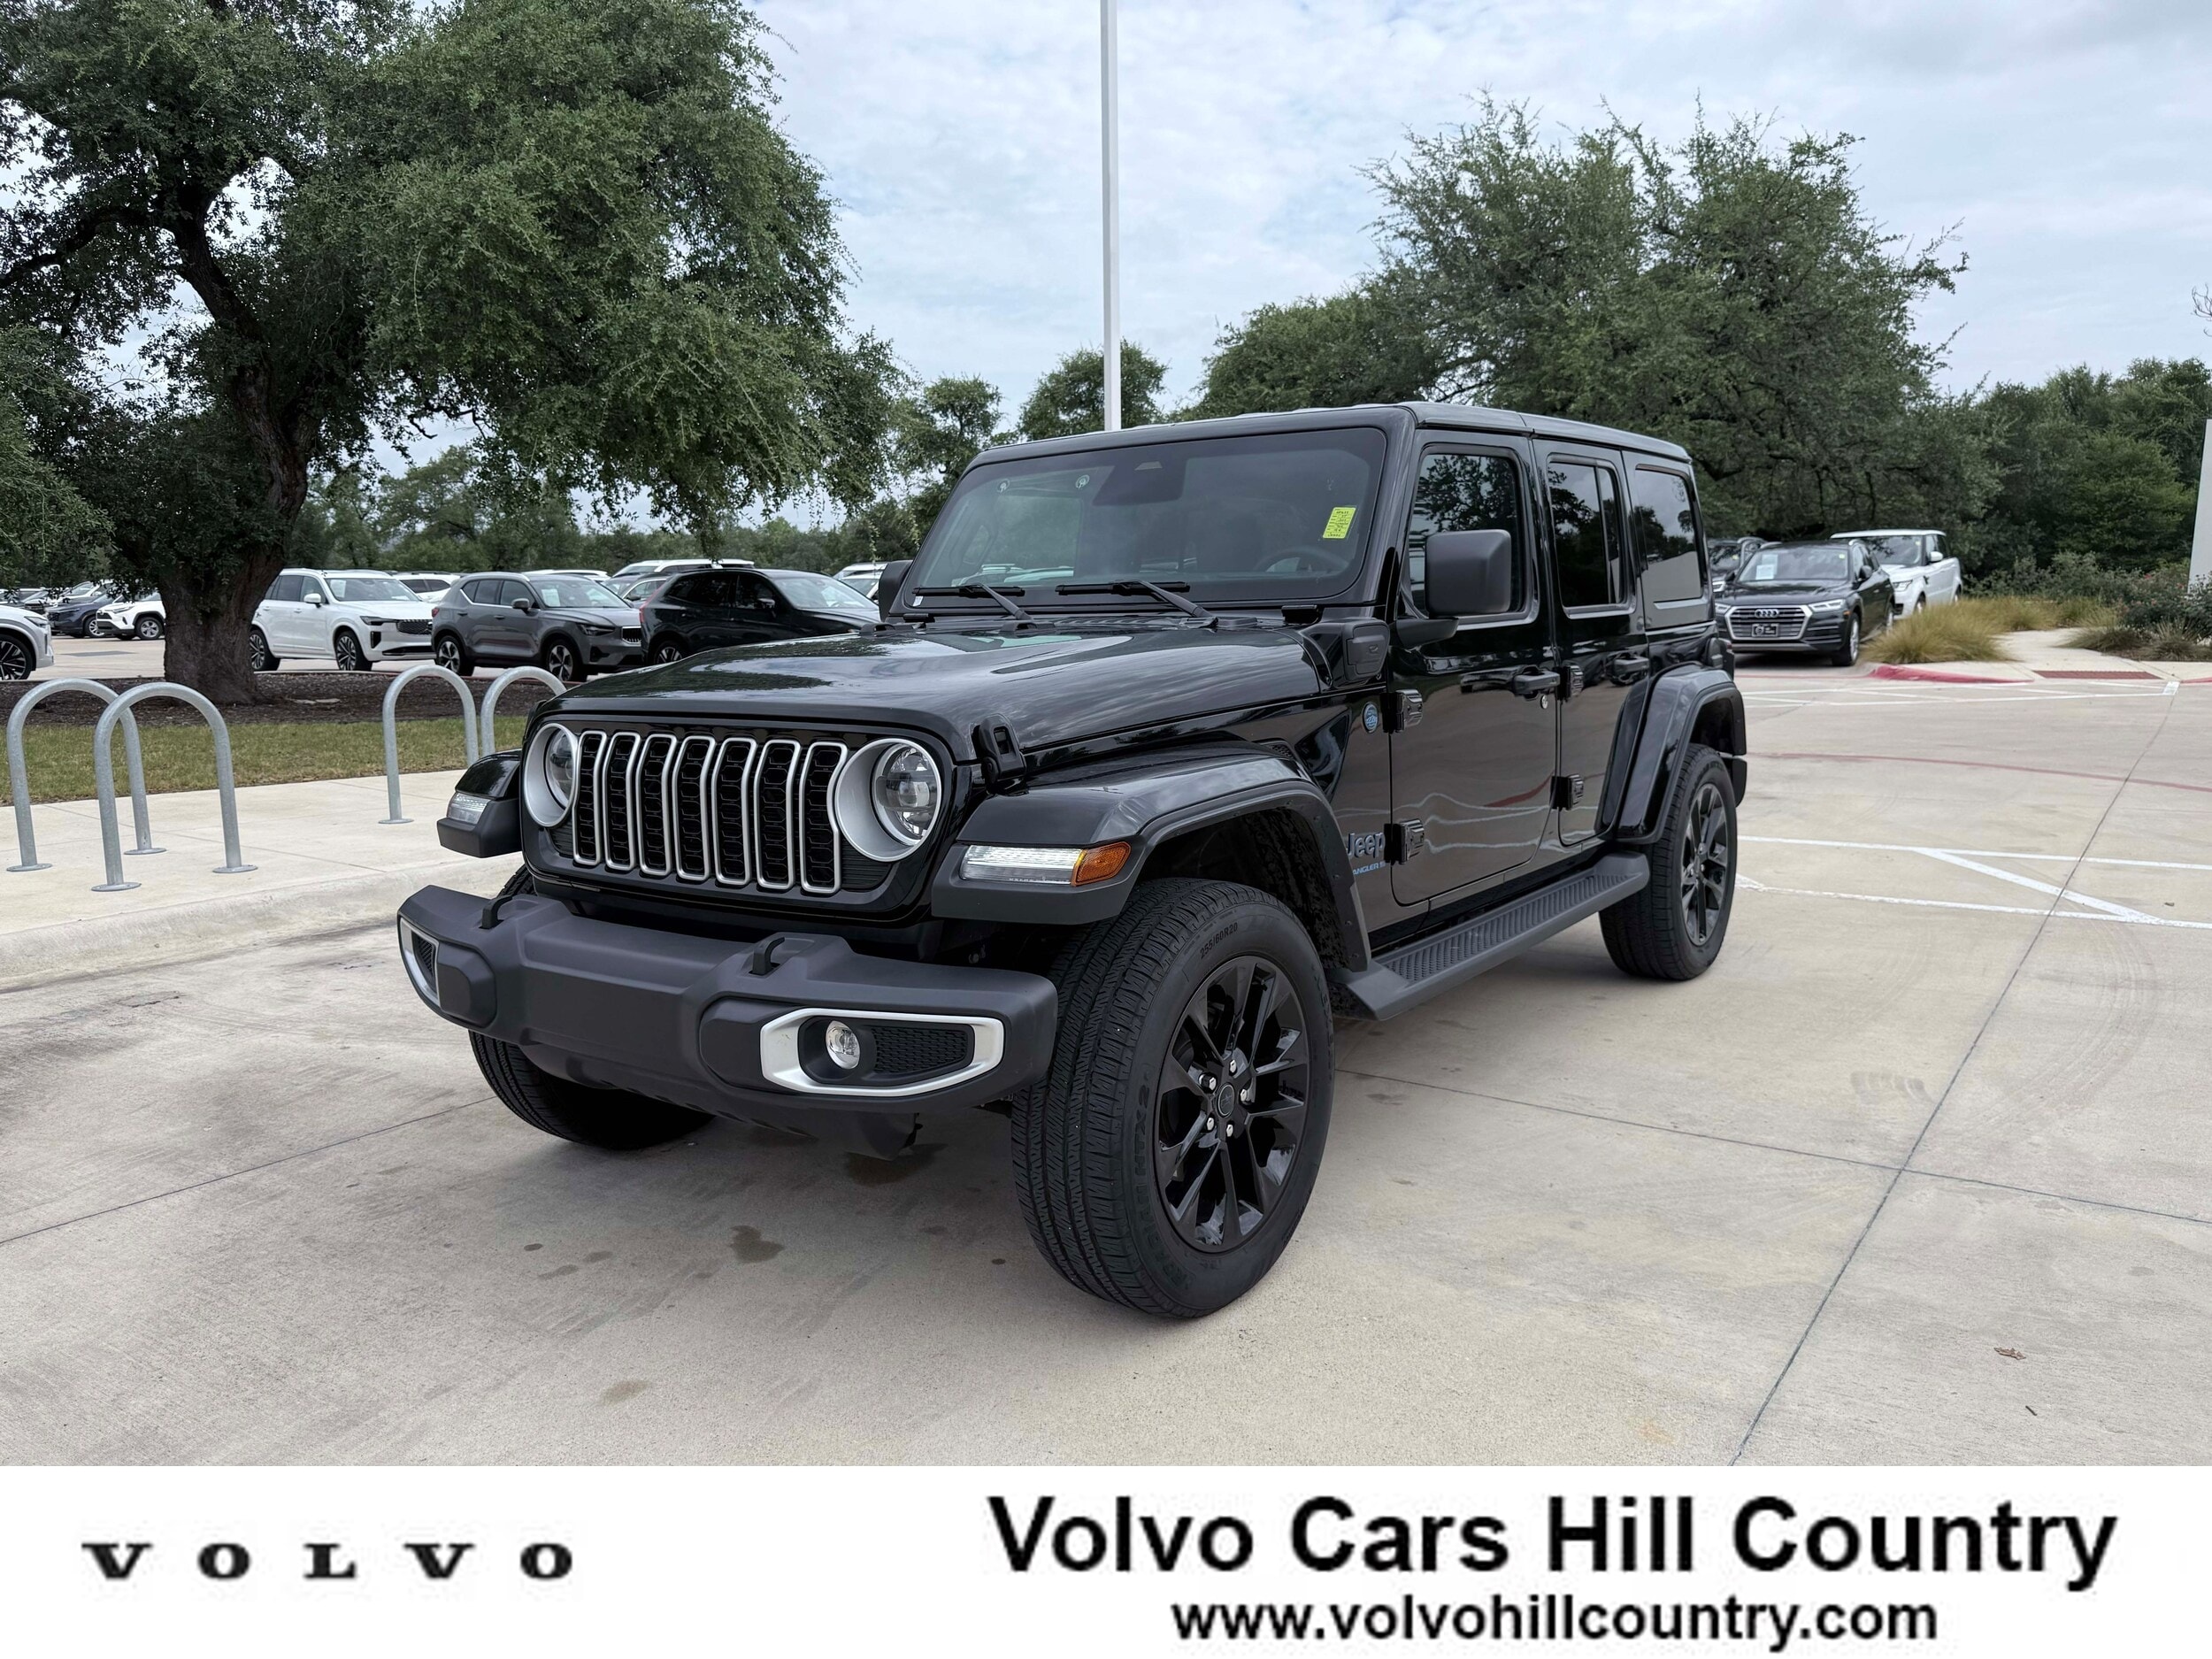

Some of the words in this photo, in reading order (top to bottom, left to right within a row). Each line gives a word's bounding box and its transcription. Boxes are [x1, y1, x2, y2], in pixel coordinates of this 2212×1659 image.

[1348, 832, 1386, 858] Jeep
[1352, 862, 1379, 875] ANGLER
[1200, 922, 1238, 960] 255/60R20
